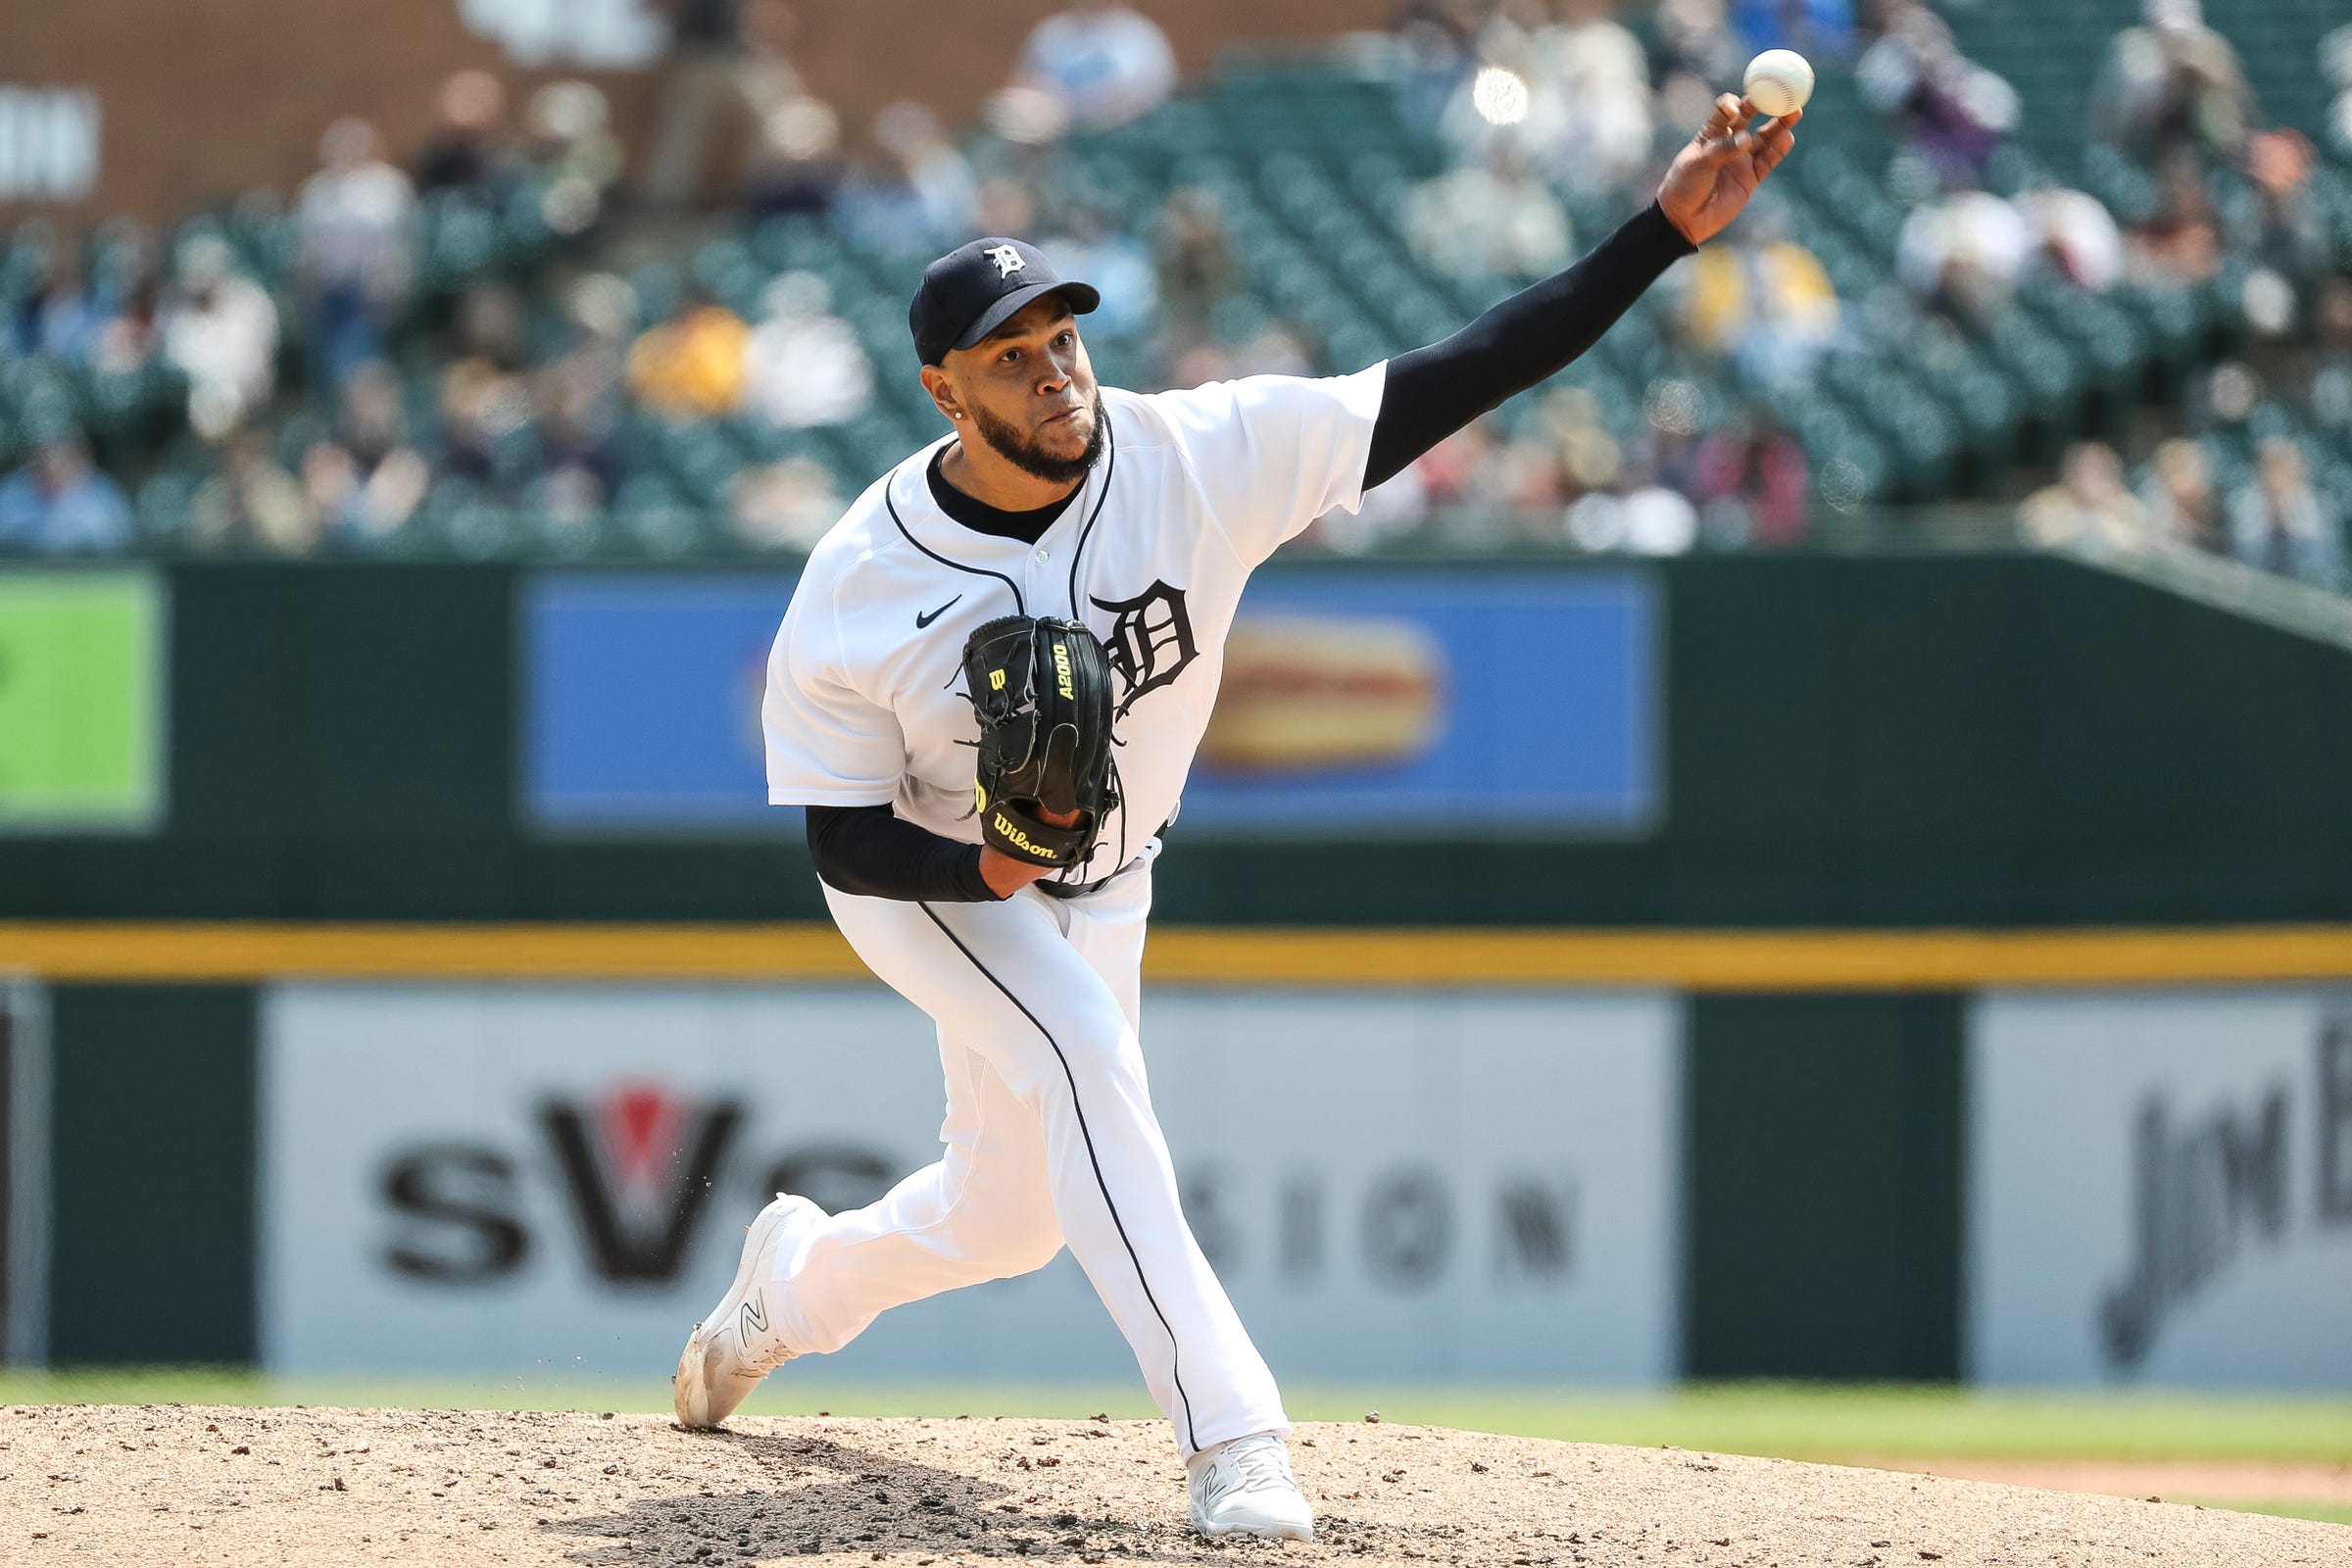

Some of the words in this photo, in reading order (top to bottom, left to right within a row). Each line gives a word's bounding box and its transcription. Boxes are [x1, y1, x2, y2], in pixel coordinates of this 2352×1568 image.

[983, 244, 1027, 280] D
[1053, 644, 1074, 701] A2000
[1089, 578, 1200, 724] D
